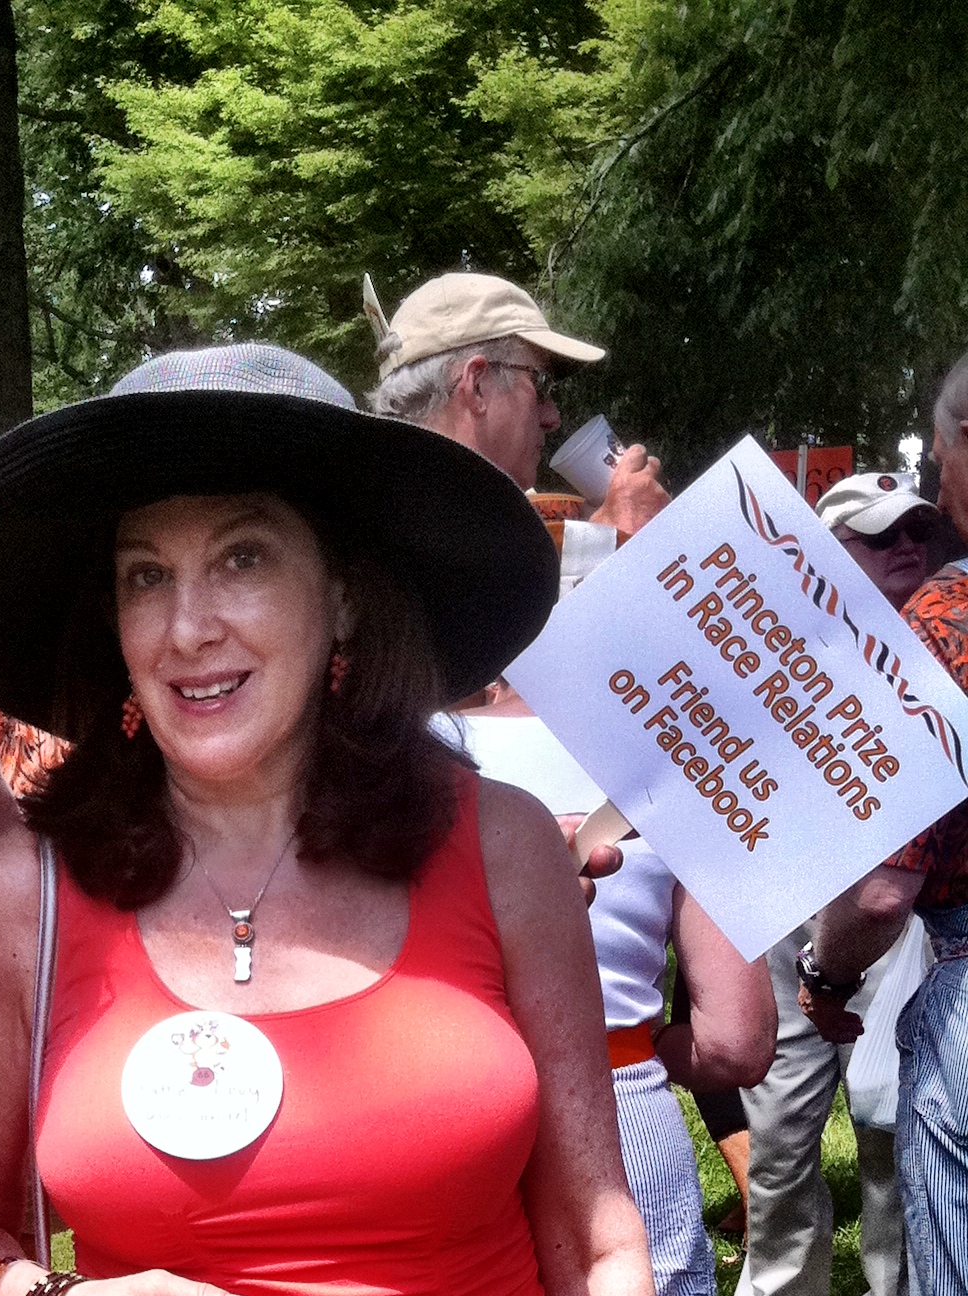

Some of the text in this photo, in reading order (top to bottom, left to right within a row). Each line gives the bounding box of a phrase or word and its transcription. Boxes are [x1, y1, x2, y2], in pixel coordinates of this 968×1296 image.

[608, 669, 770, 852] on Facebook
[656, 554, 882, 821] in Race Relations
[657, 660, 779, 801] Friend us
[699, 542, 834, 704] Princeton
[826, 694, 900, 783] Prize
